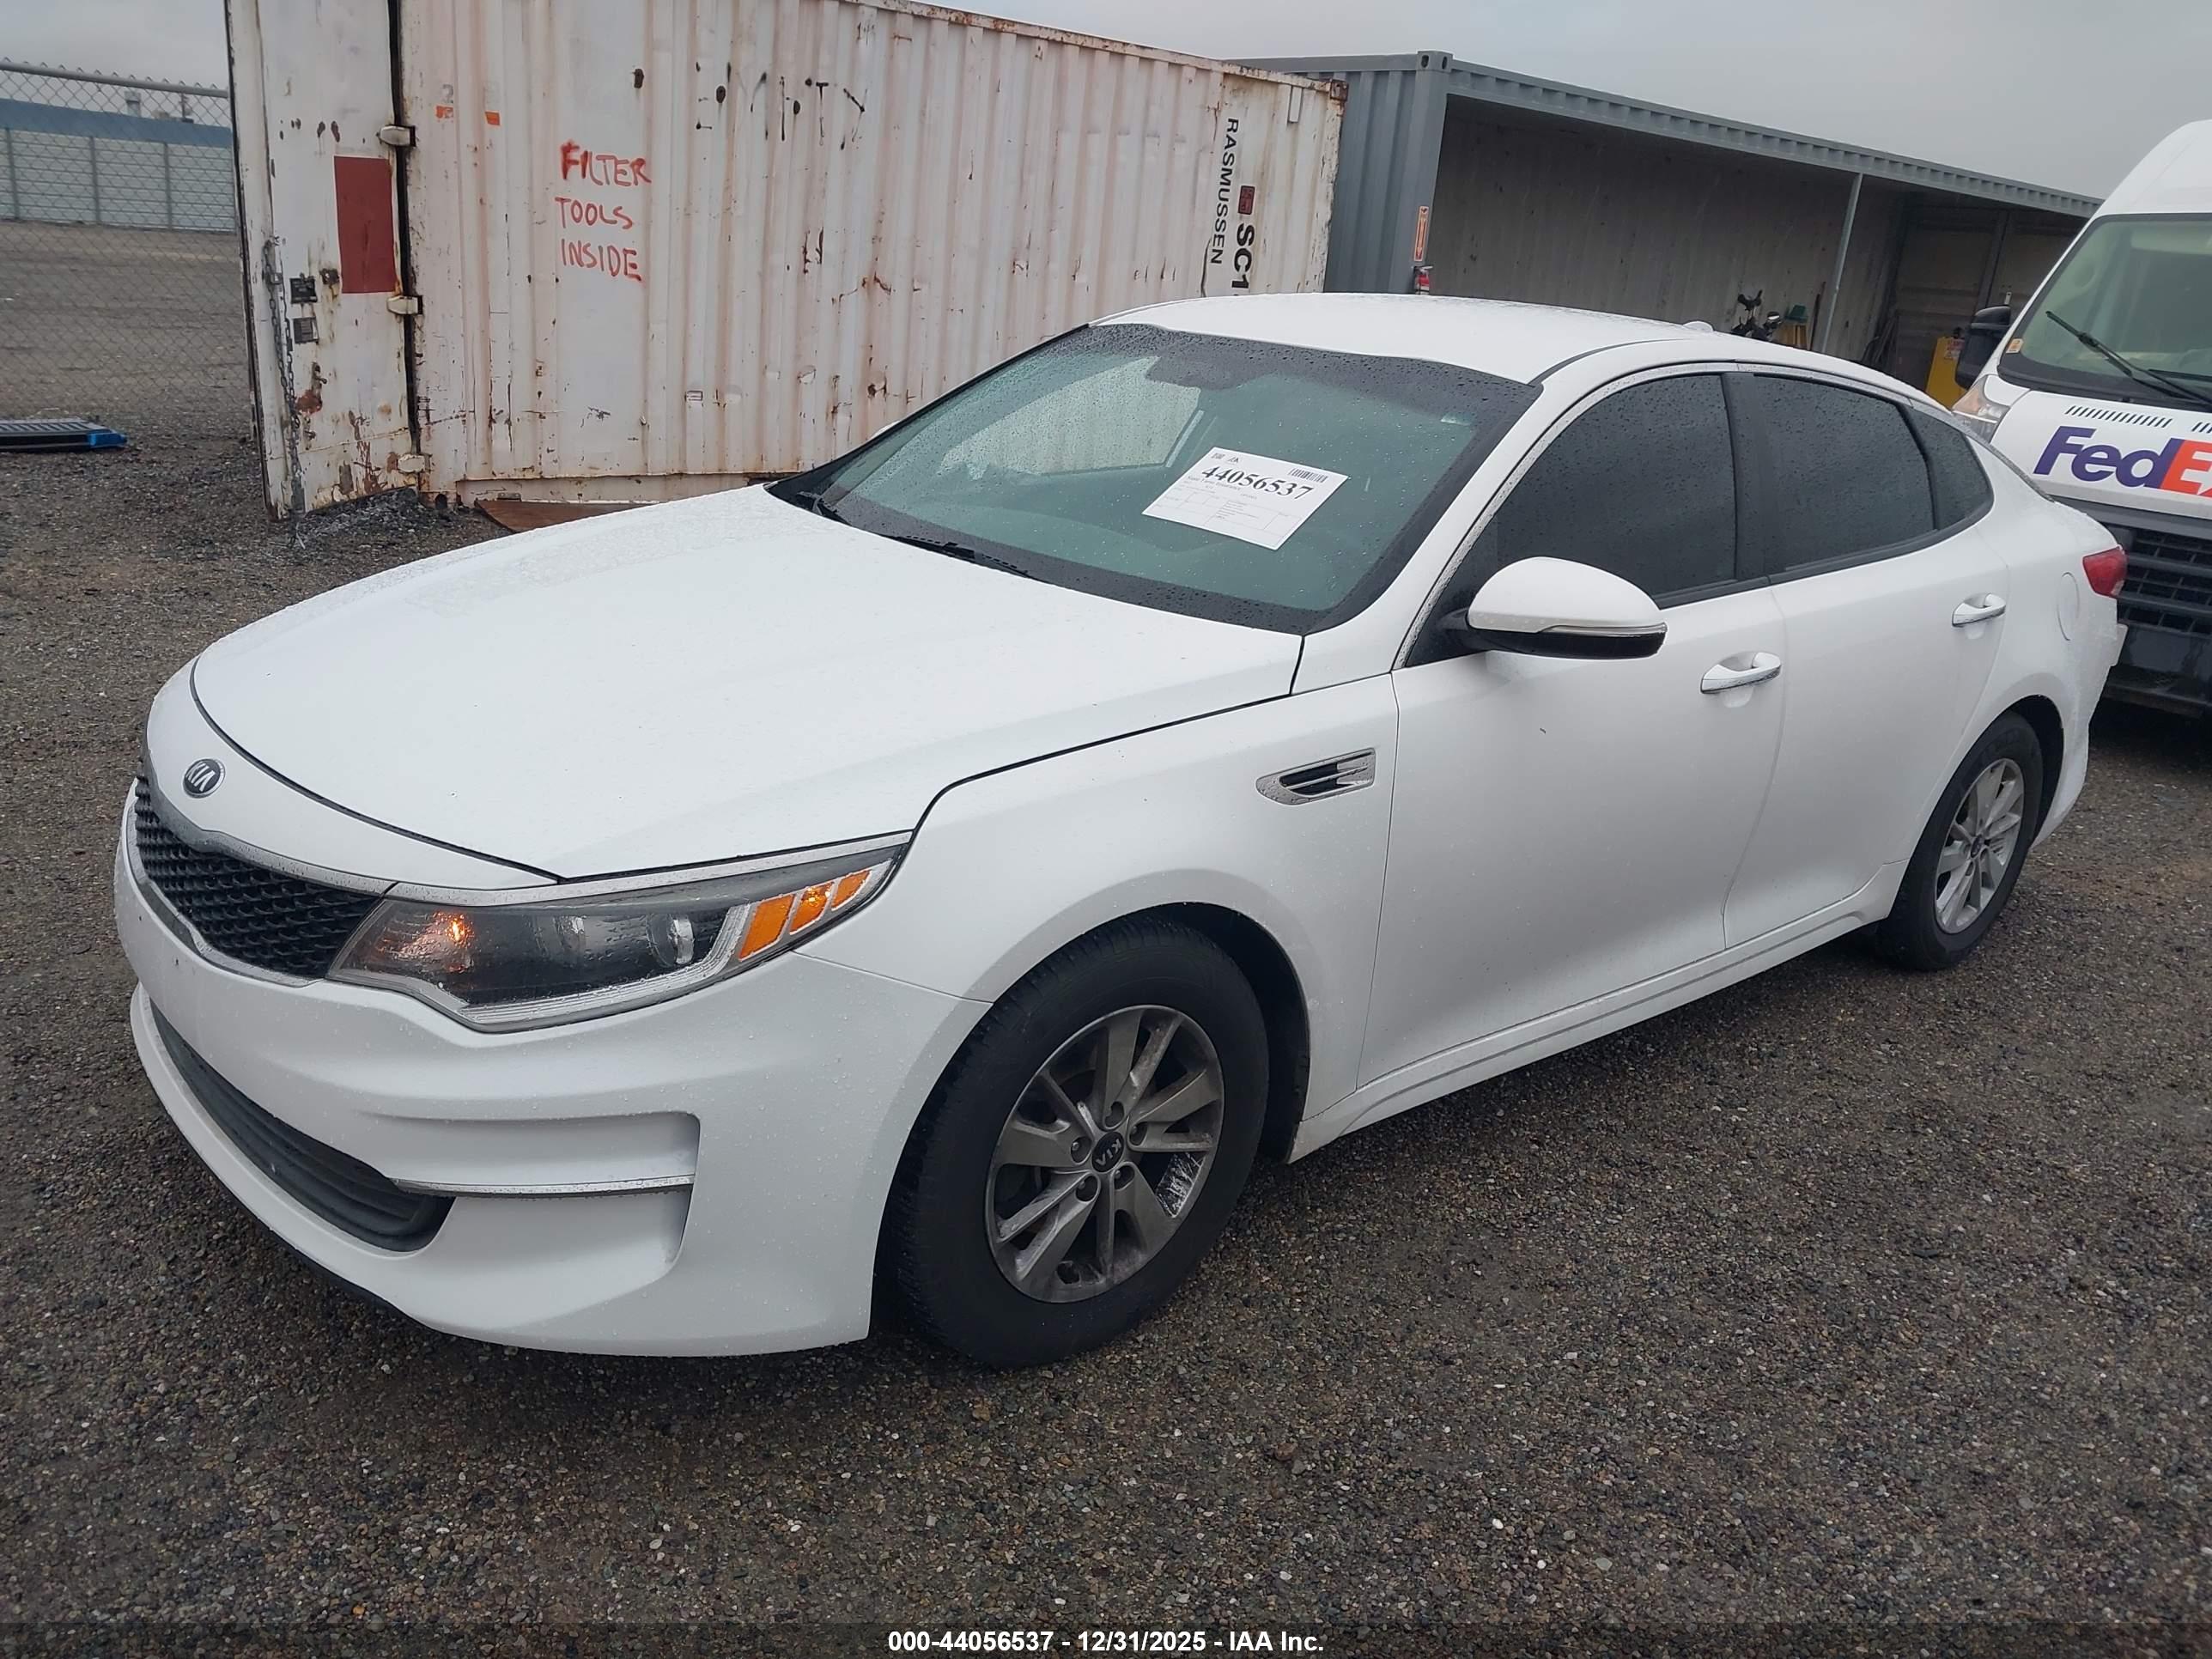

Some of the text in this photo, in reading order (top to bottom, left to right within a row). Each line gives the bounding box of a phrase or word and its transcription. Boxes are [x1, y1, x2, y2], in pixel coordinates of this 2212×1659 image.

[560, 141, 653, 187] FILTER
[554, 196, 634, 230] TOOLS
[1211, 118, 1240, 264] RASMUSSEN
[561, 238, 643, 282] INSIDE
[1231, 222, 1255, 296] SC1
[1202, 466, 1314, 500] 44056537
[1095, 1139, 1122, 1166] KIA
